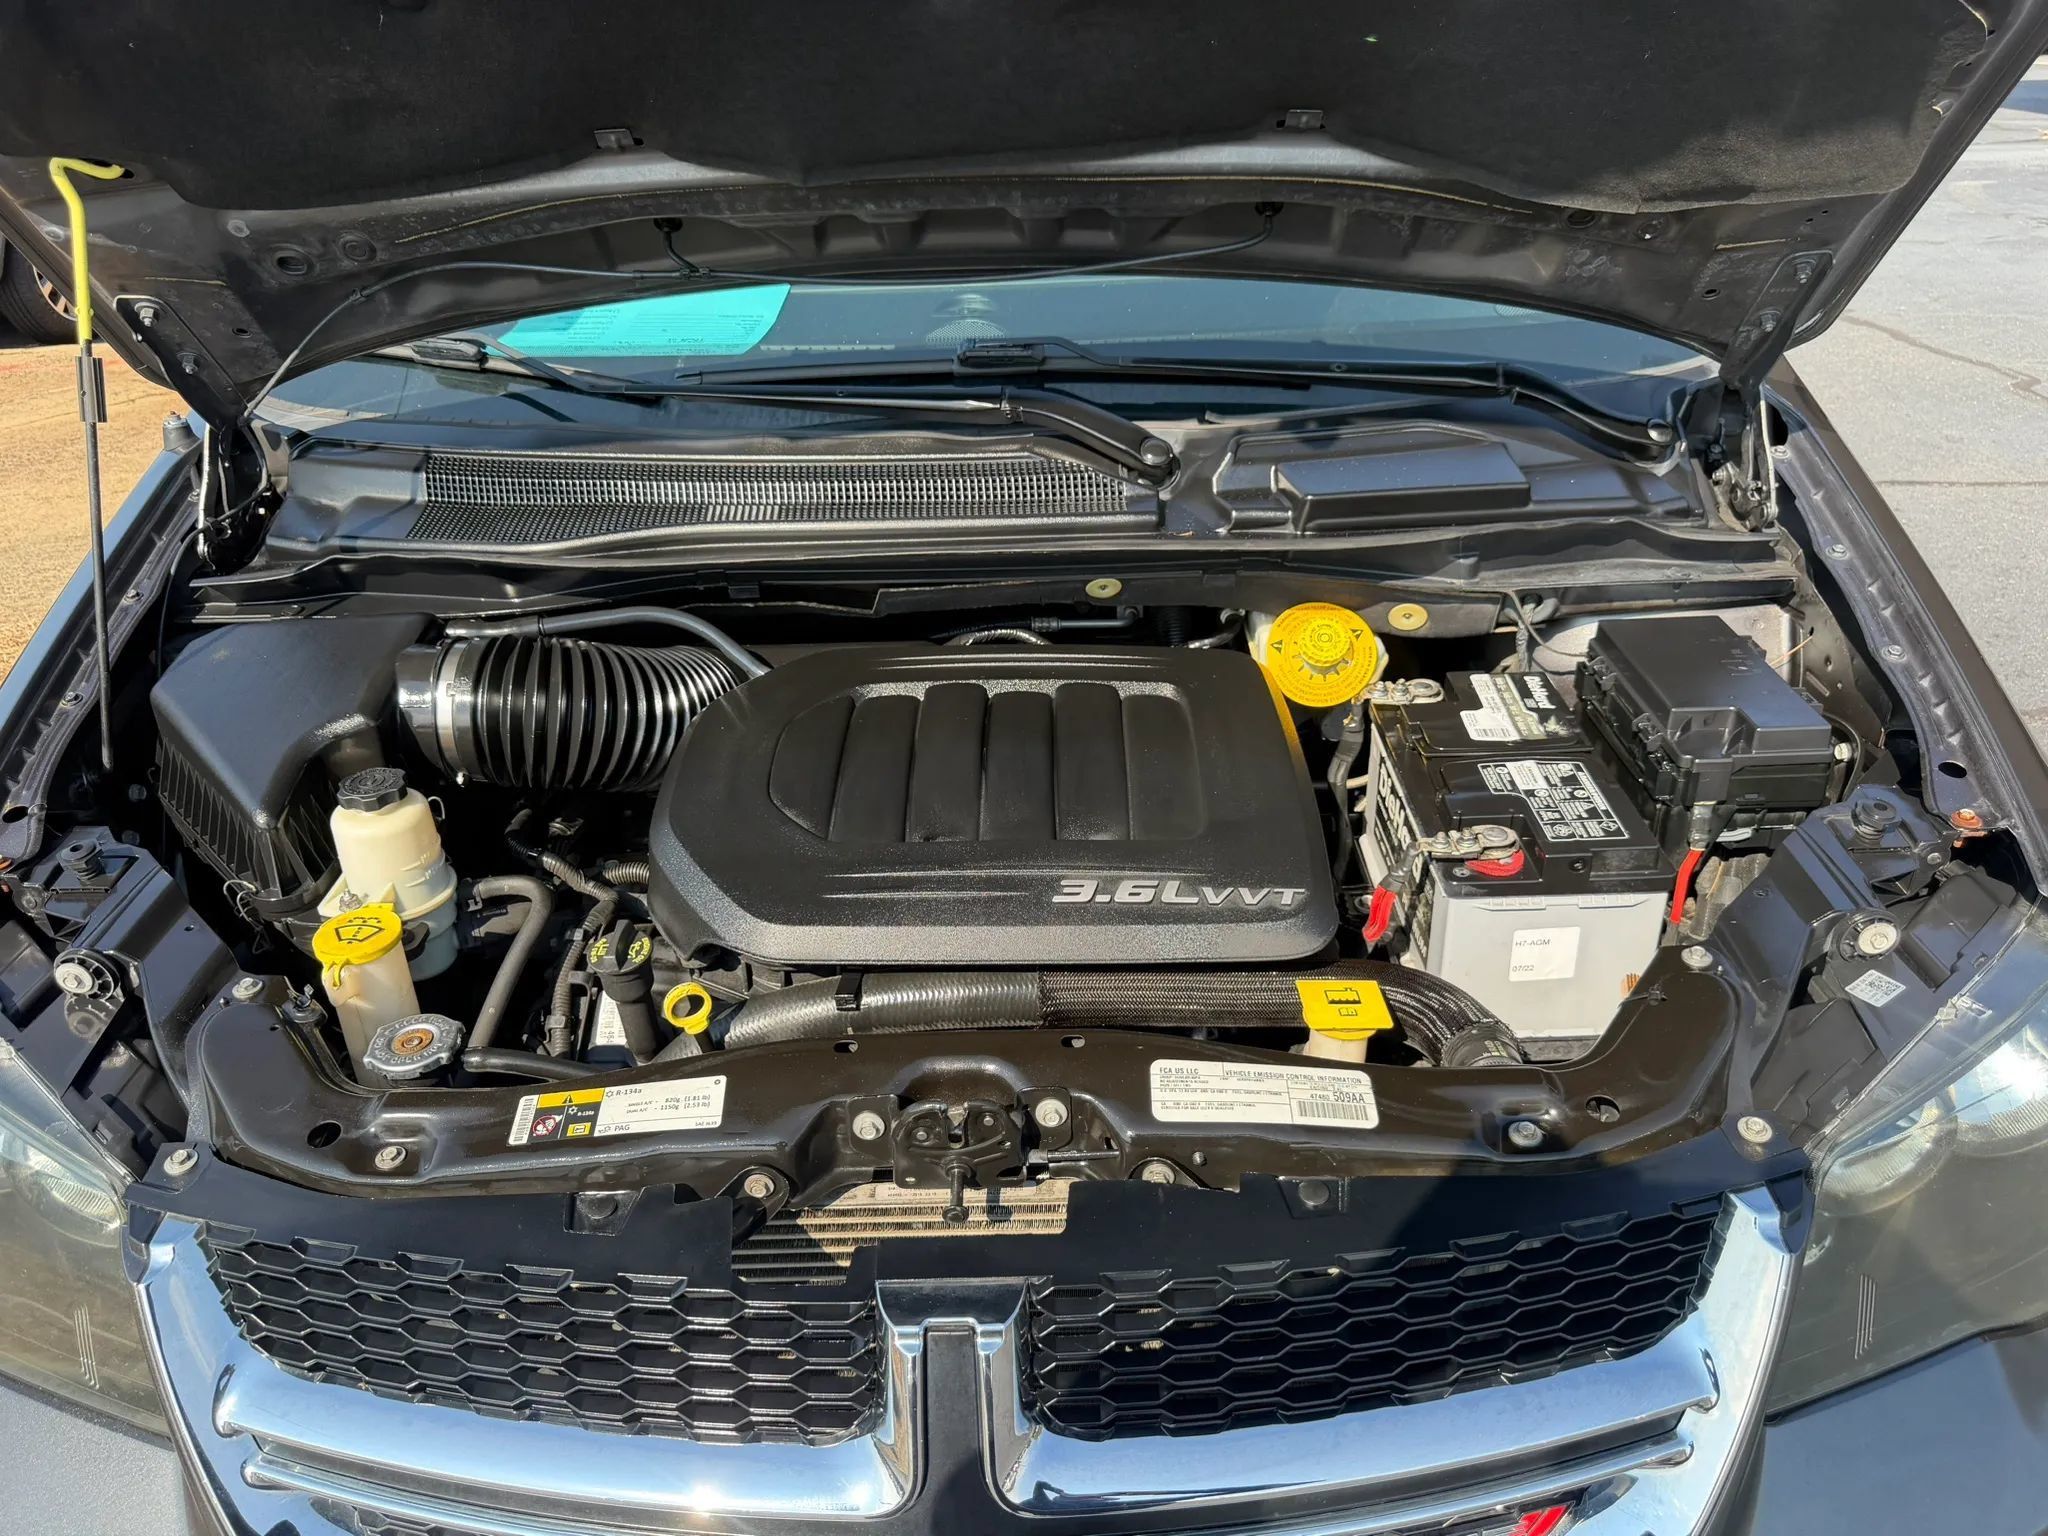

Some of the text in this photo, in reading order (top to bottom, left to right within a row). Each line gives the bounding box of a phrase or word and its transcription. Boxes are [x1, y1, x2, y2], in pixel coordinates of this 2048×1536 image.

[1523, 675, 1557, 709] DieHard
[1379, 762, 1424, 883] DieHad
[1052, 880, 1306, 906] 3.6L VVT
[1515, 939, 1551, 947] H7-AGM
[1511, 964, 1535, 973] 07/22
[1159, 1067, 1199, 1075] FCA US LLC
[1225, 1069, 1362, 1084] VEHICLE EMISSION CONTROL INFORMATION
[615, 1088, 642, 1096] R-134a
[1333, 1091, 1366, 1103] 509AA
[614, 1124, 630, 1132] PAG
